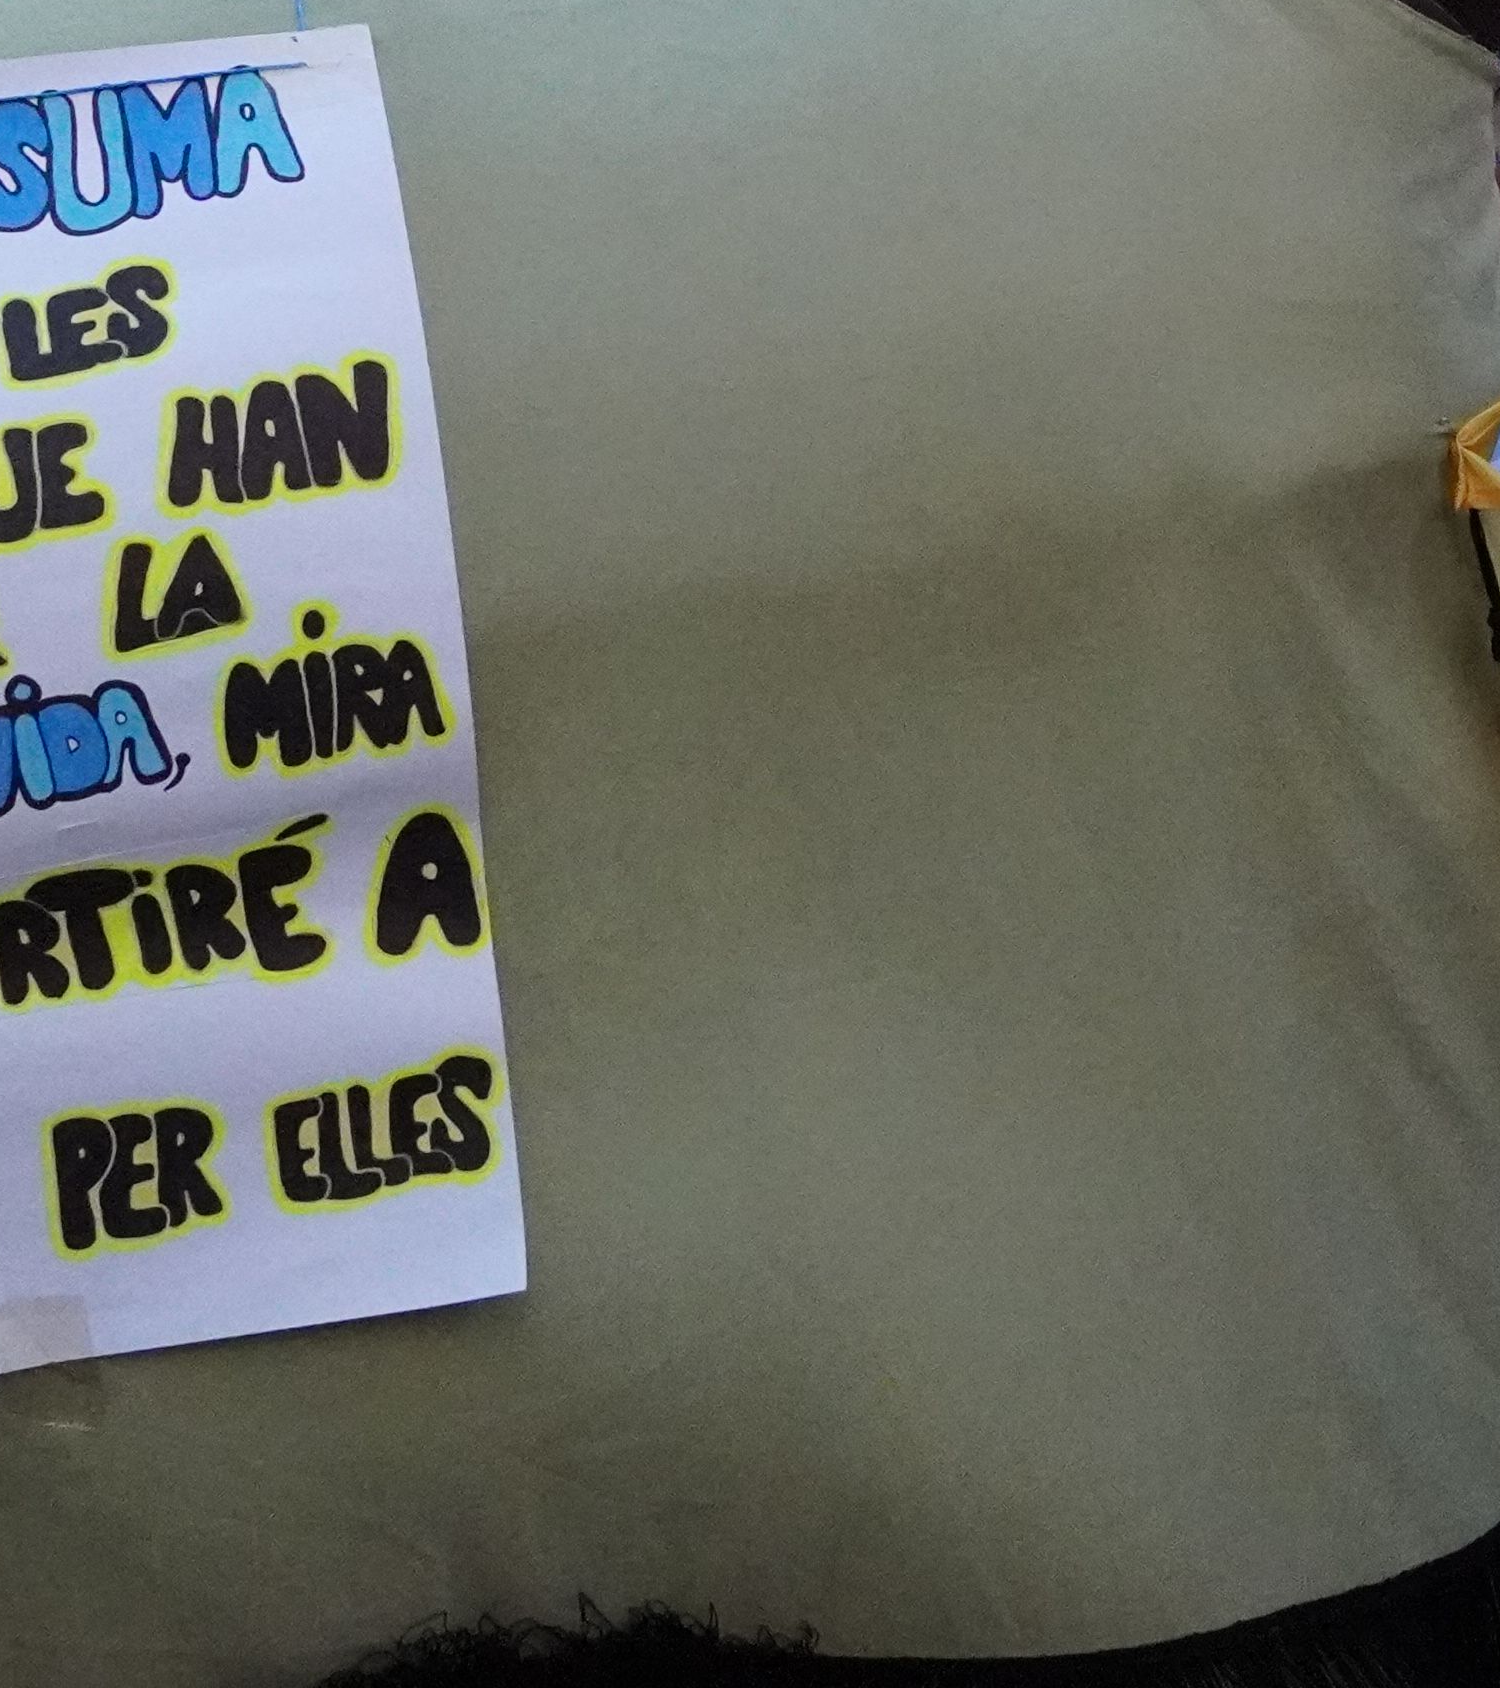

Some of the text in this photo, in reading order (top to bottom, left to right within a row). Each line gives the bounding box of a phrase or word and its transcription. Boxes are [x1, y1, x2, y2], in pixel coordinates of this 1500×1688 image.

[1, 264, 173, 382] LES
[166, 361, 391, 506] HAN
[115, 535, 243, 654] LA
[377, 810, 483, 957] A
[53, 1108, 223, 1250] PER
[275, 1055, 495, 1206] ELLES
